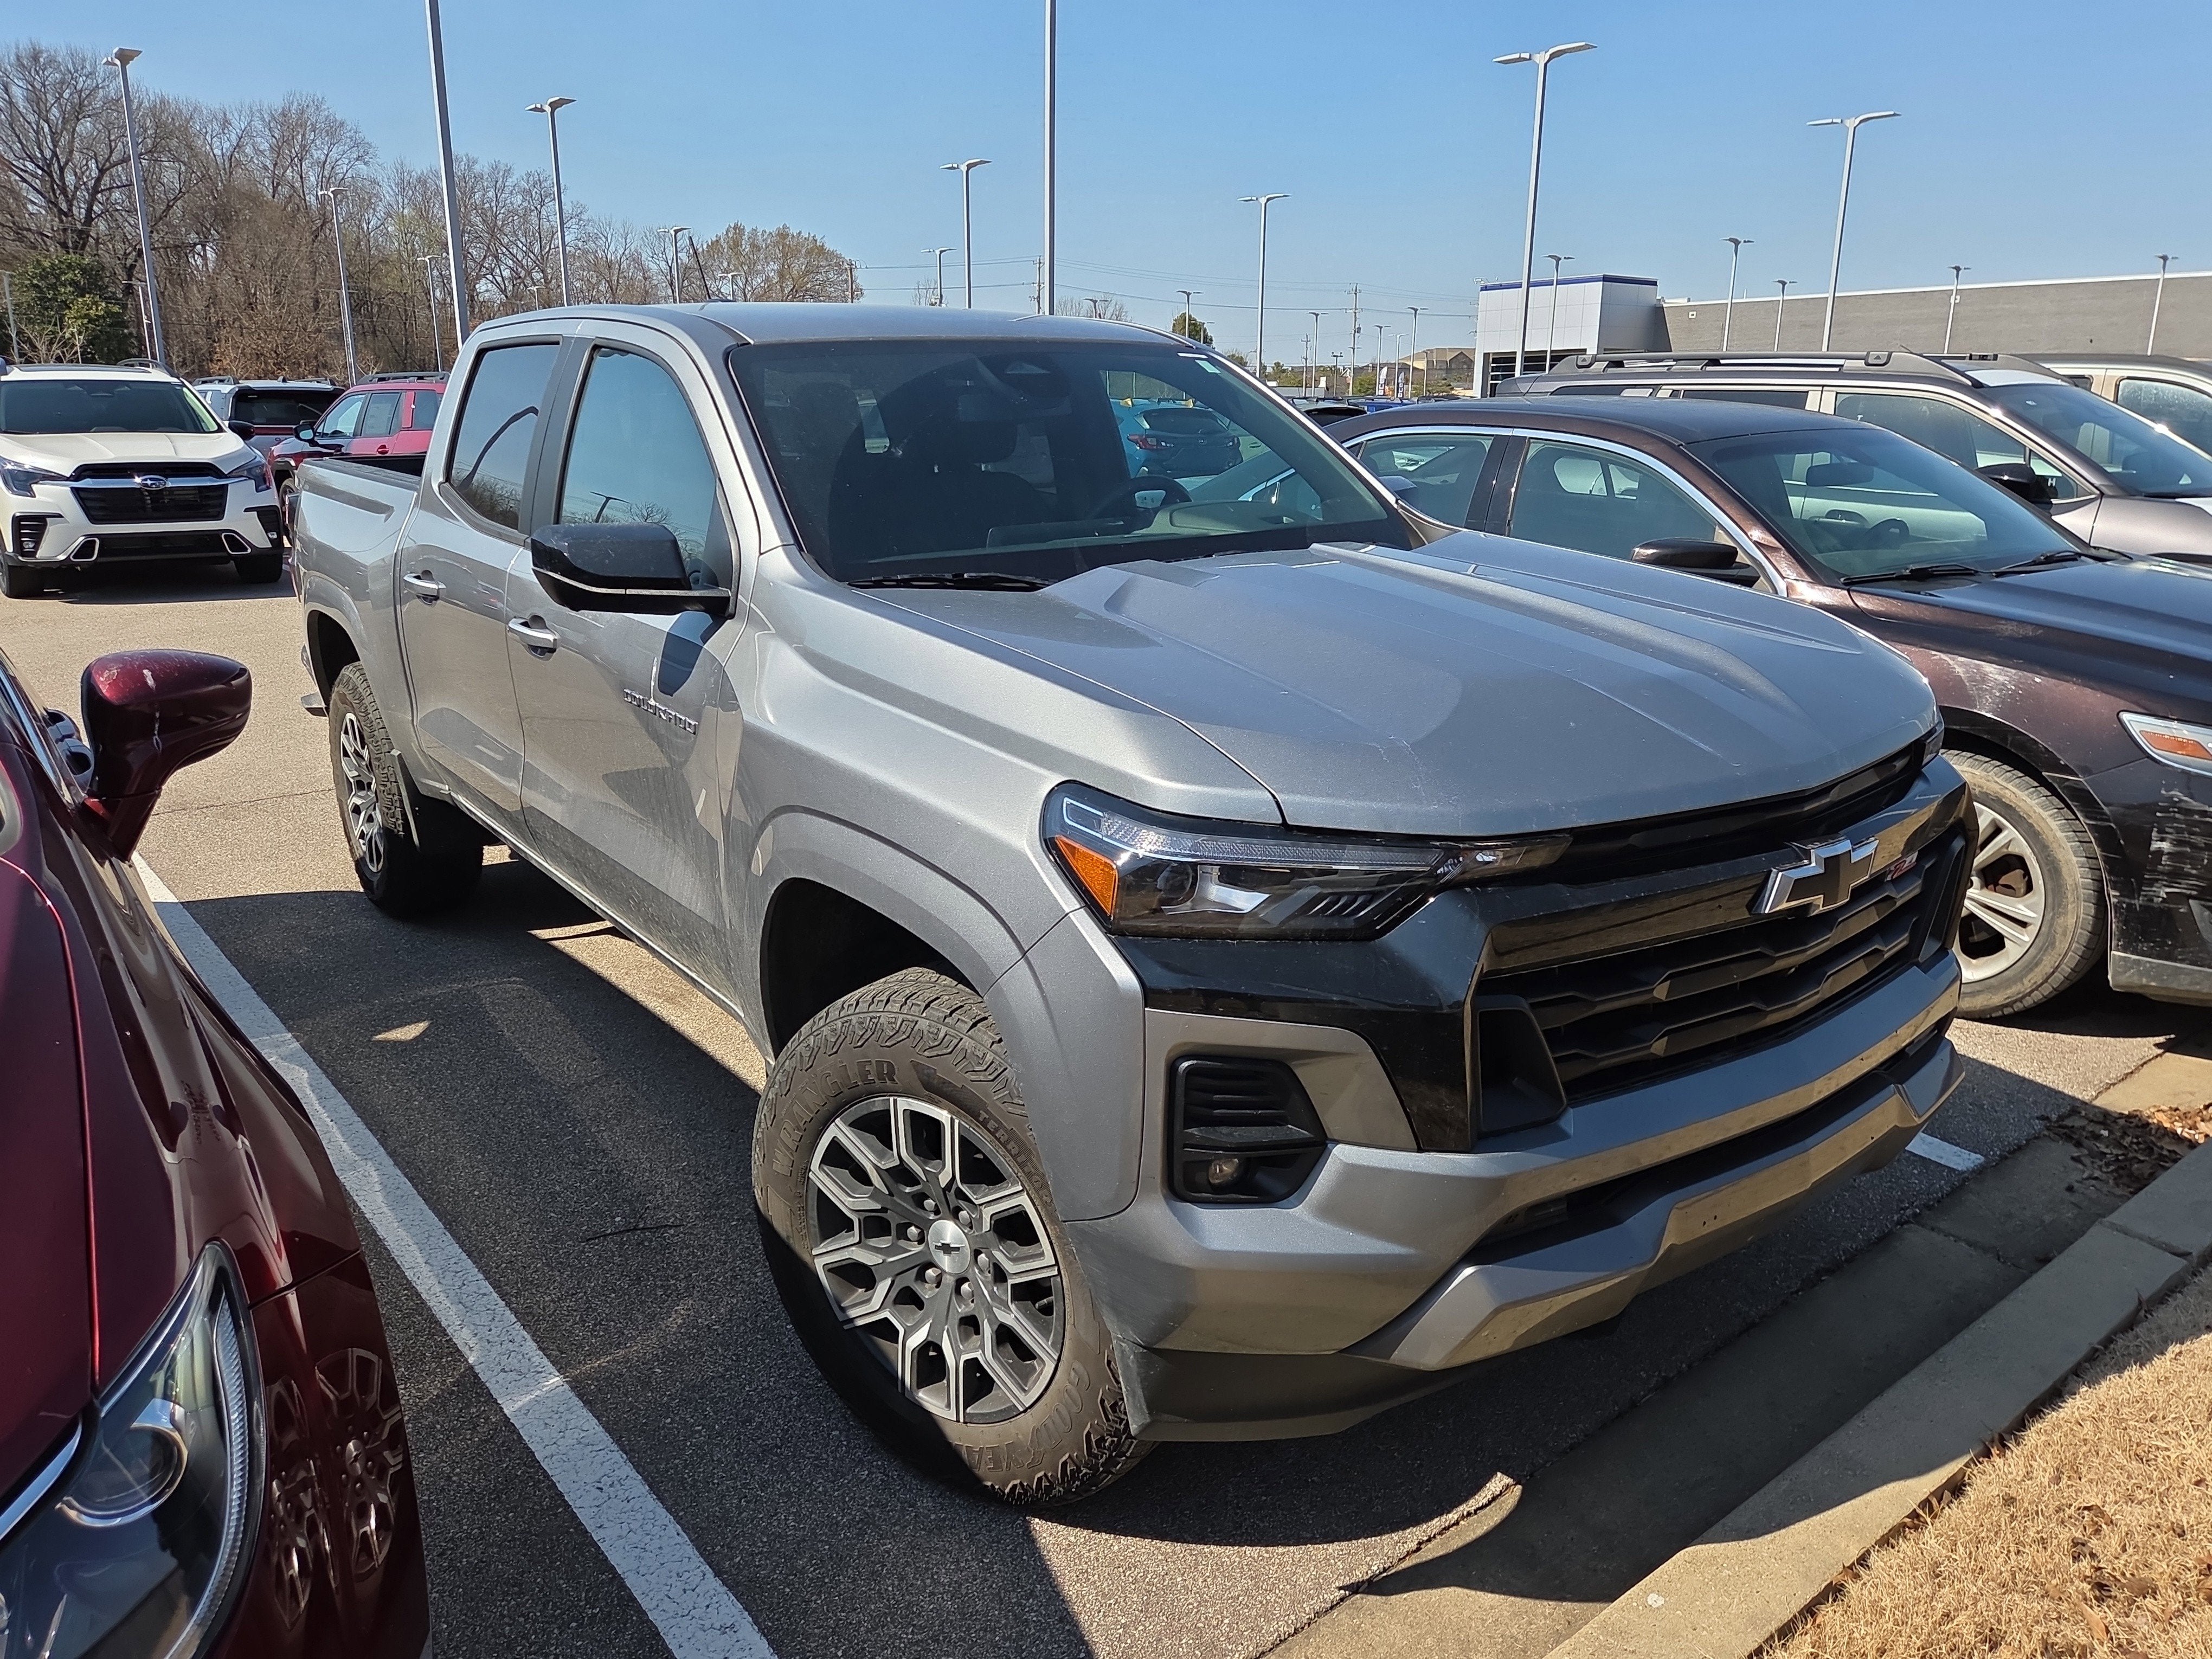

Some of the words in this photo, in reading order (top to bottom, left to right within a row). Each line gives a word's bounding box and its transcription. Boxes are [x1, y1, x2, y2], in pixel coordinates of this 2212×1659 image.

[623, 688, 698, 735] COLORADO
[773, 1059, 899, 1177] WRANGLER
[979, 1110, 1057, 1211] TERRITOR
